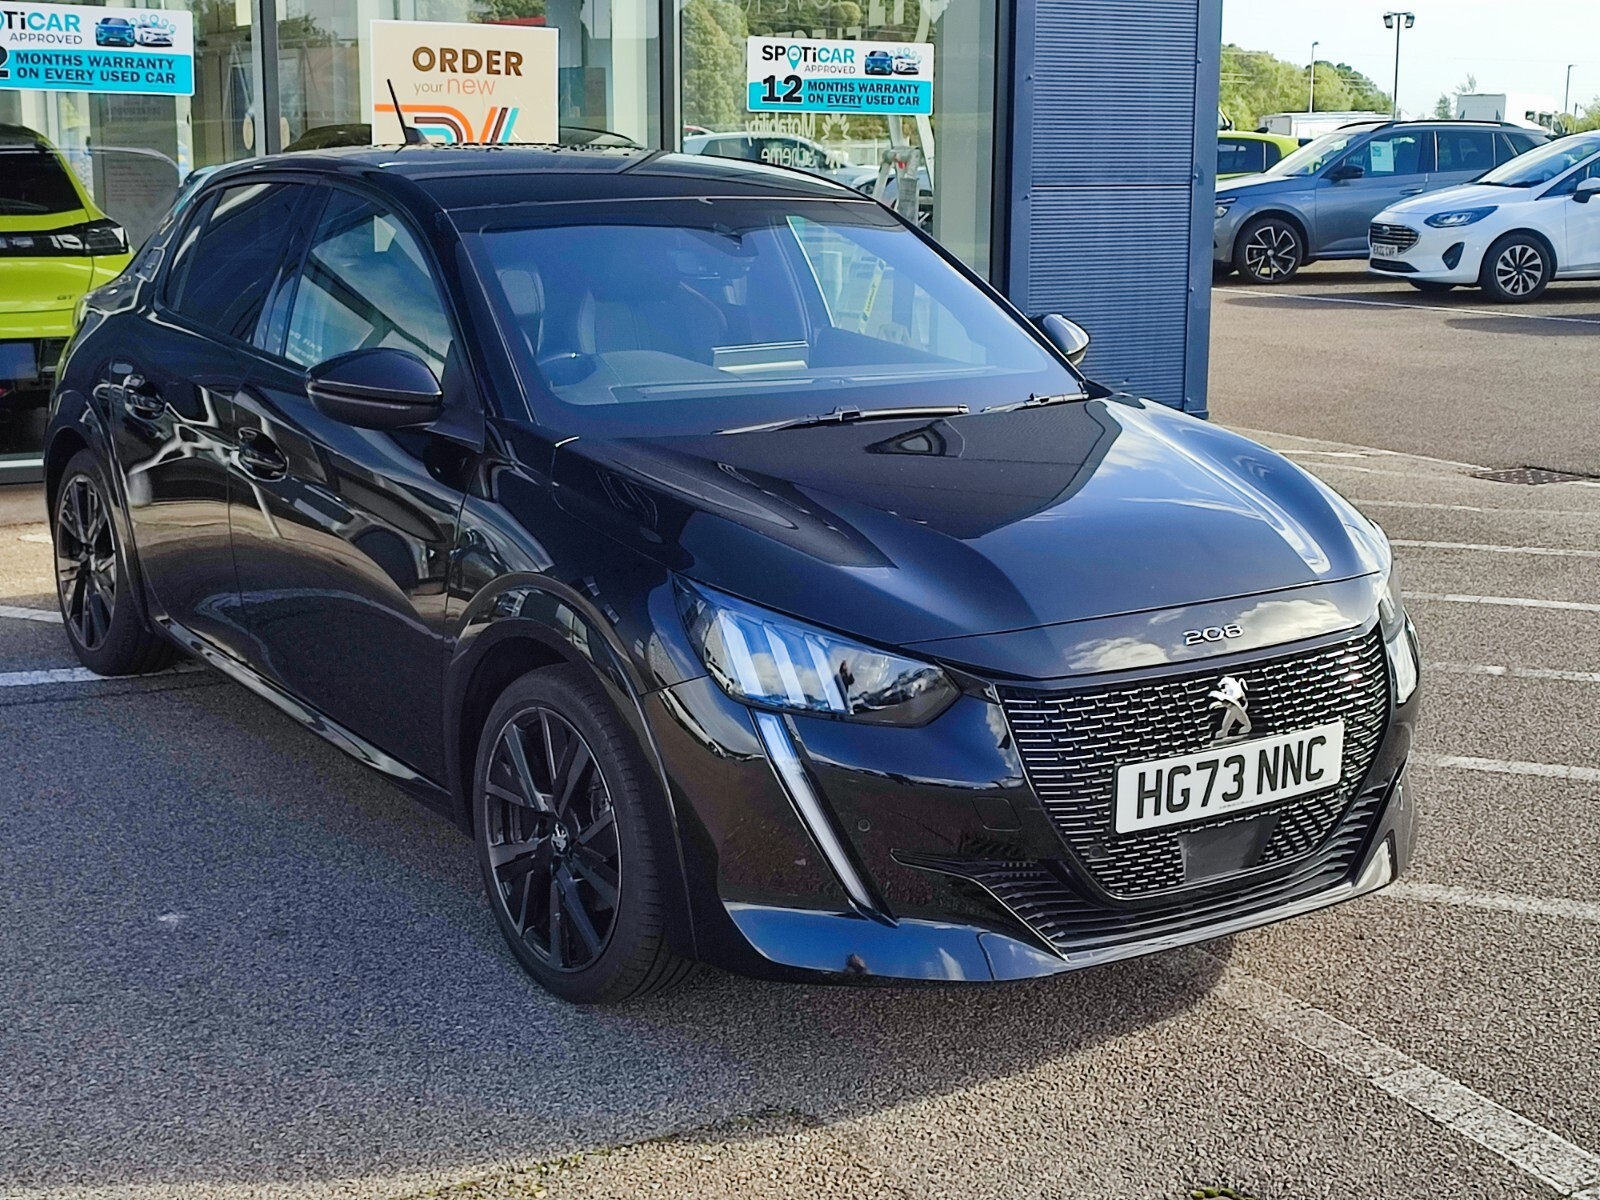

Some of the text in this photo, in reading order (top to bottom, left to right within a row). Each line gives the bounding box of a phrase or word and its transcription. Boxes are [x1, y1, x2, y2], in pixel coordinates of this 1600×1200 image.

[0, 10, 81, 33] TiCAR
[9, 32, 83, 45] APPROVED
[15, 52, 83, 67] MONTHS
[87, 55, 175, 70] WARRANTY
[412, 46, 524, 77] ORDER
[804, 64, 856, 75] APPROVED
[17, 67, 176, 84] ON EVERY USED CAR
[413, 77, 496, 96] your new
[761, 74, 803, 104] 12
[807, 81, 920, 95] MONTHS WARRANTY
[808, 93, 920, 106] ON EVERY USED CAR
[1184, 623, 1243, 645] 208
[1136, 735, 1327, 821] HG73 NNC
